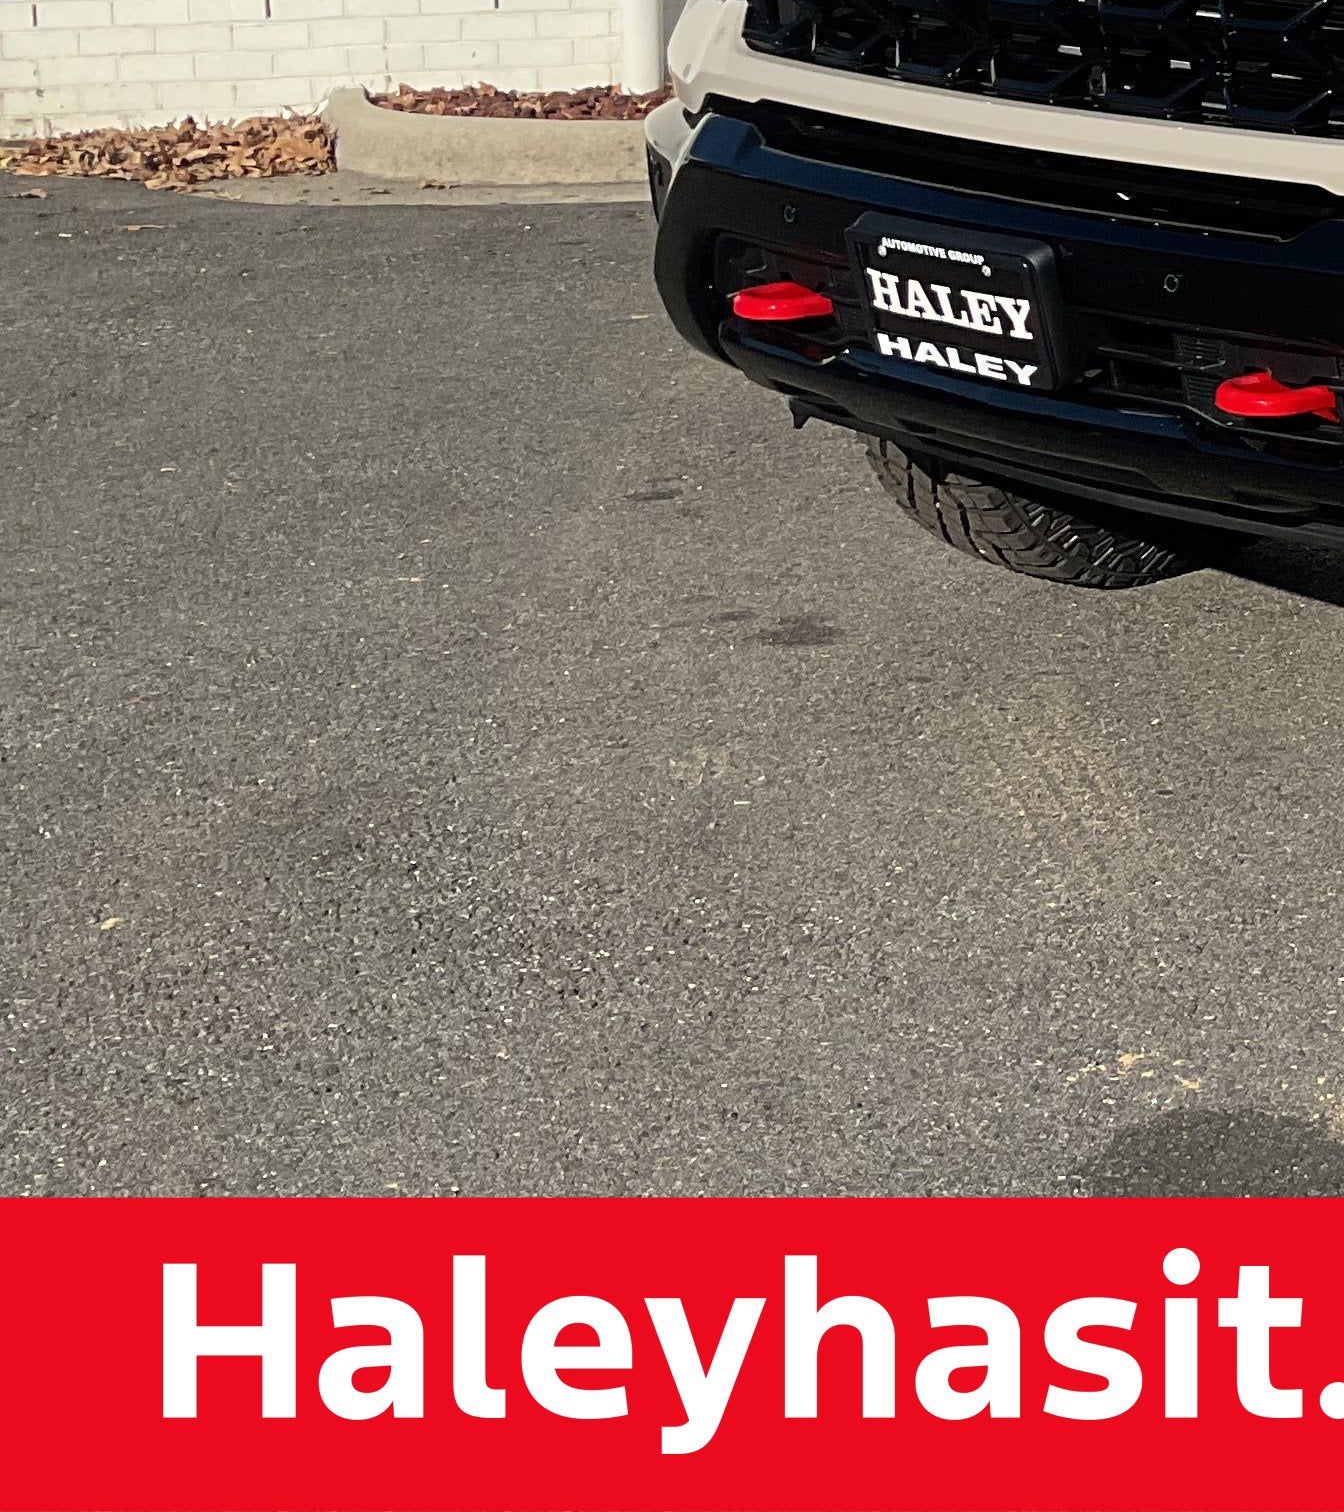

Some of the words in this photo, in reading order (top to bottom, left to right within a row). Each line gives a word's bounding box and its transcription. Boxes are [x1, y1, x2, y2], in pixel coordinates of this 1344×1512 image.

[881, 236, 947, 259] AUTOMOTIVE
[948, 249, 985, 266] GROUP
[866, 267, 1034, 340] HALEY
[876, 332, 1039, 386] HALEY
